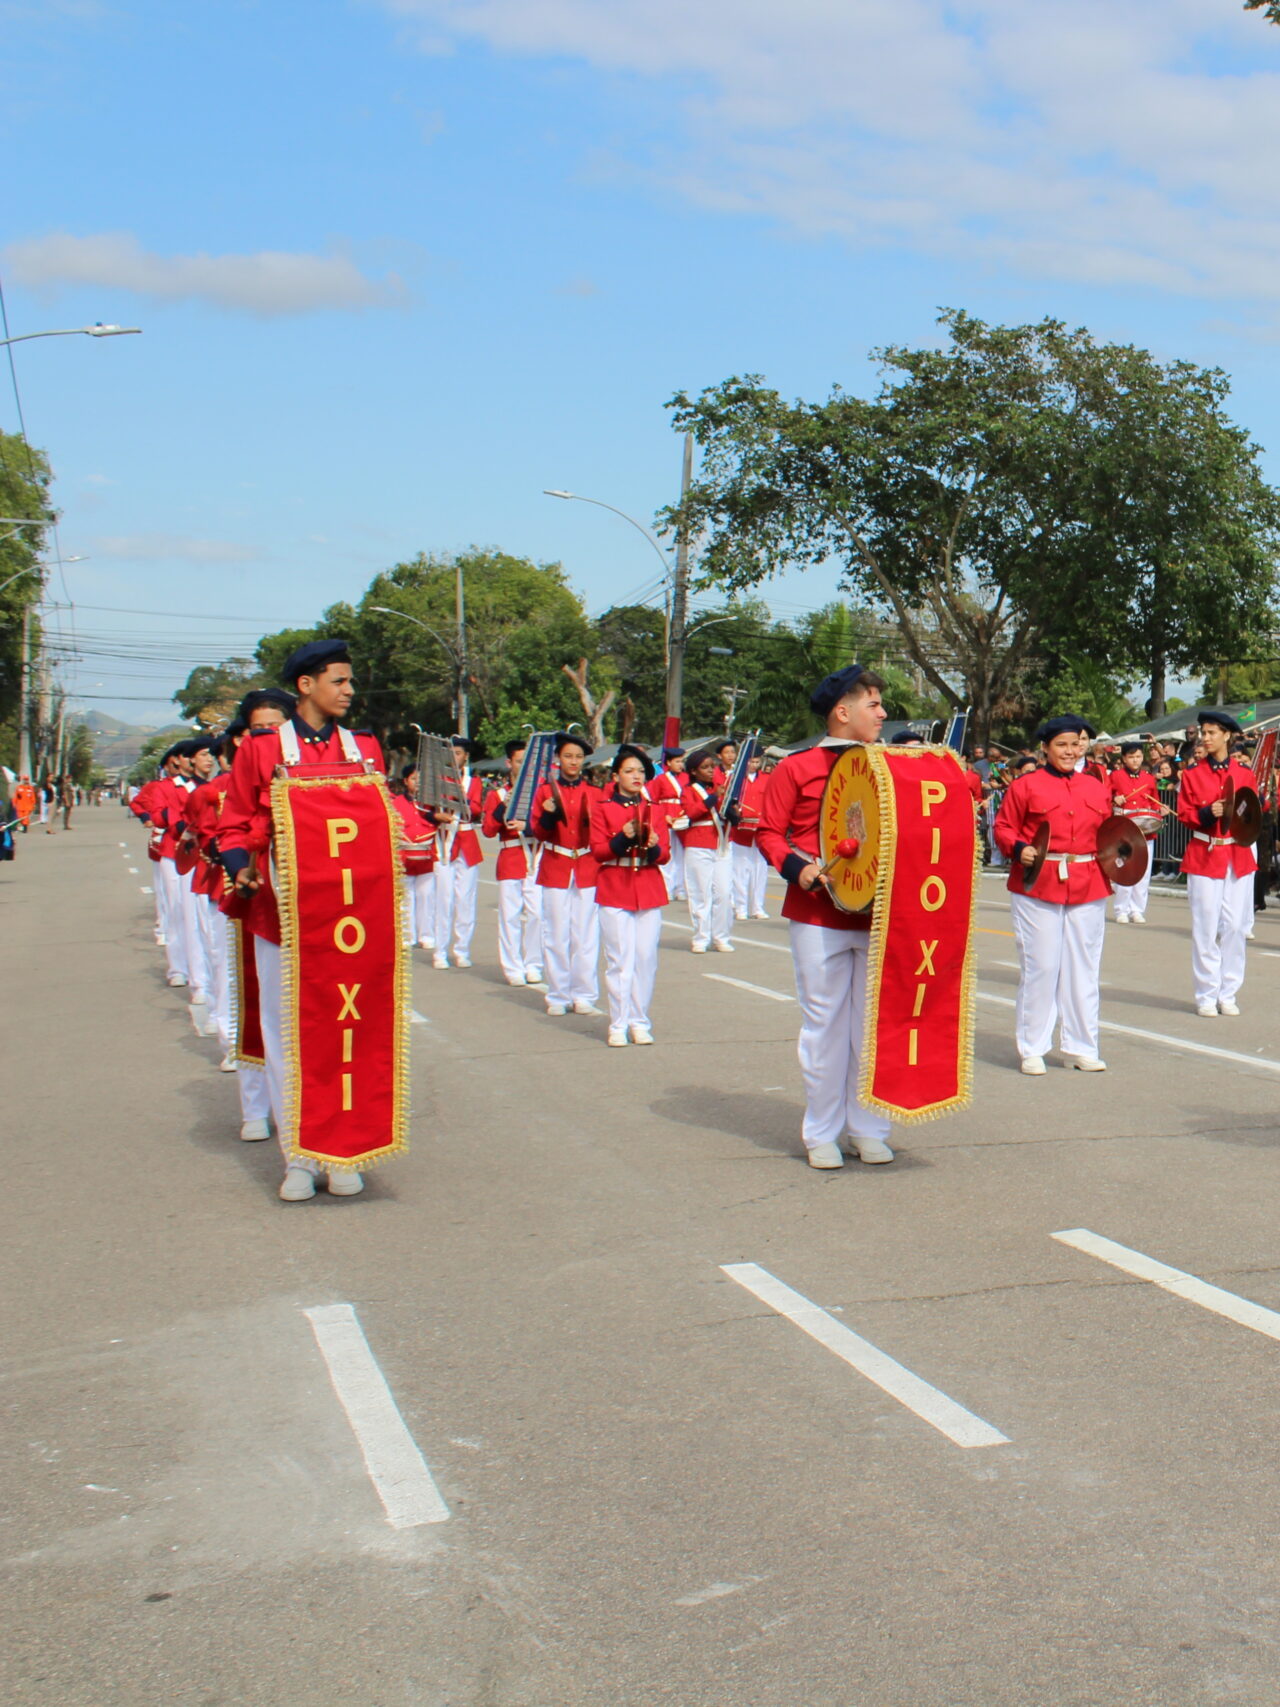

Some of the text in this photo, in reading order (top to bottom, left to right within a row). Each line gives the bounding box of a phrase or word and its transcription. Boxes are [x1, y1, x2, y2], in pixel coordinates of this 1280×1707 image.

[327, 817, 366, 1111] PIO XII
[842, 867, 862, 892] PIO
[908, 779, 947, 1066] PIO XII
